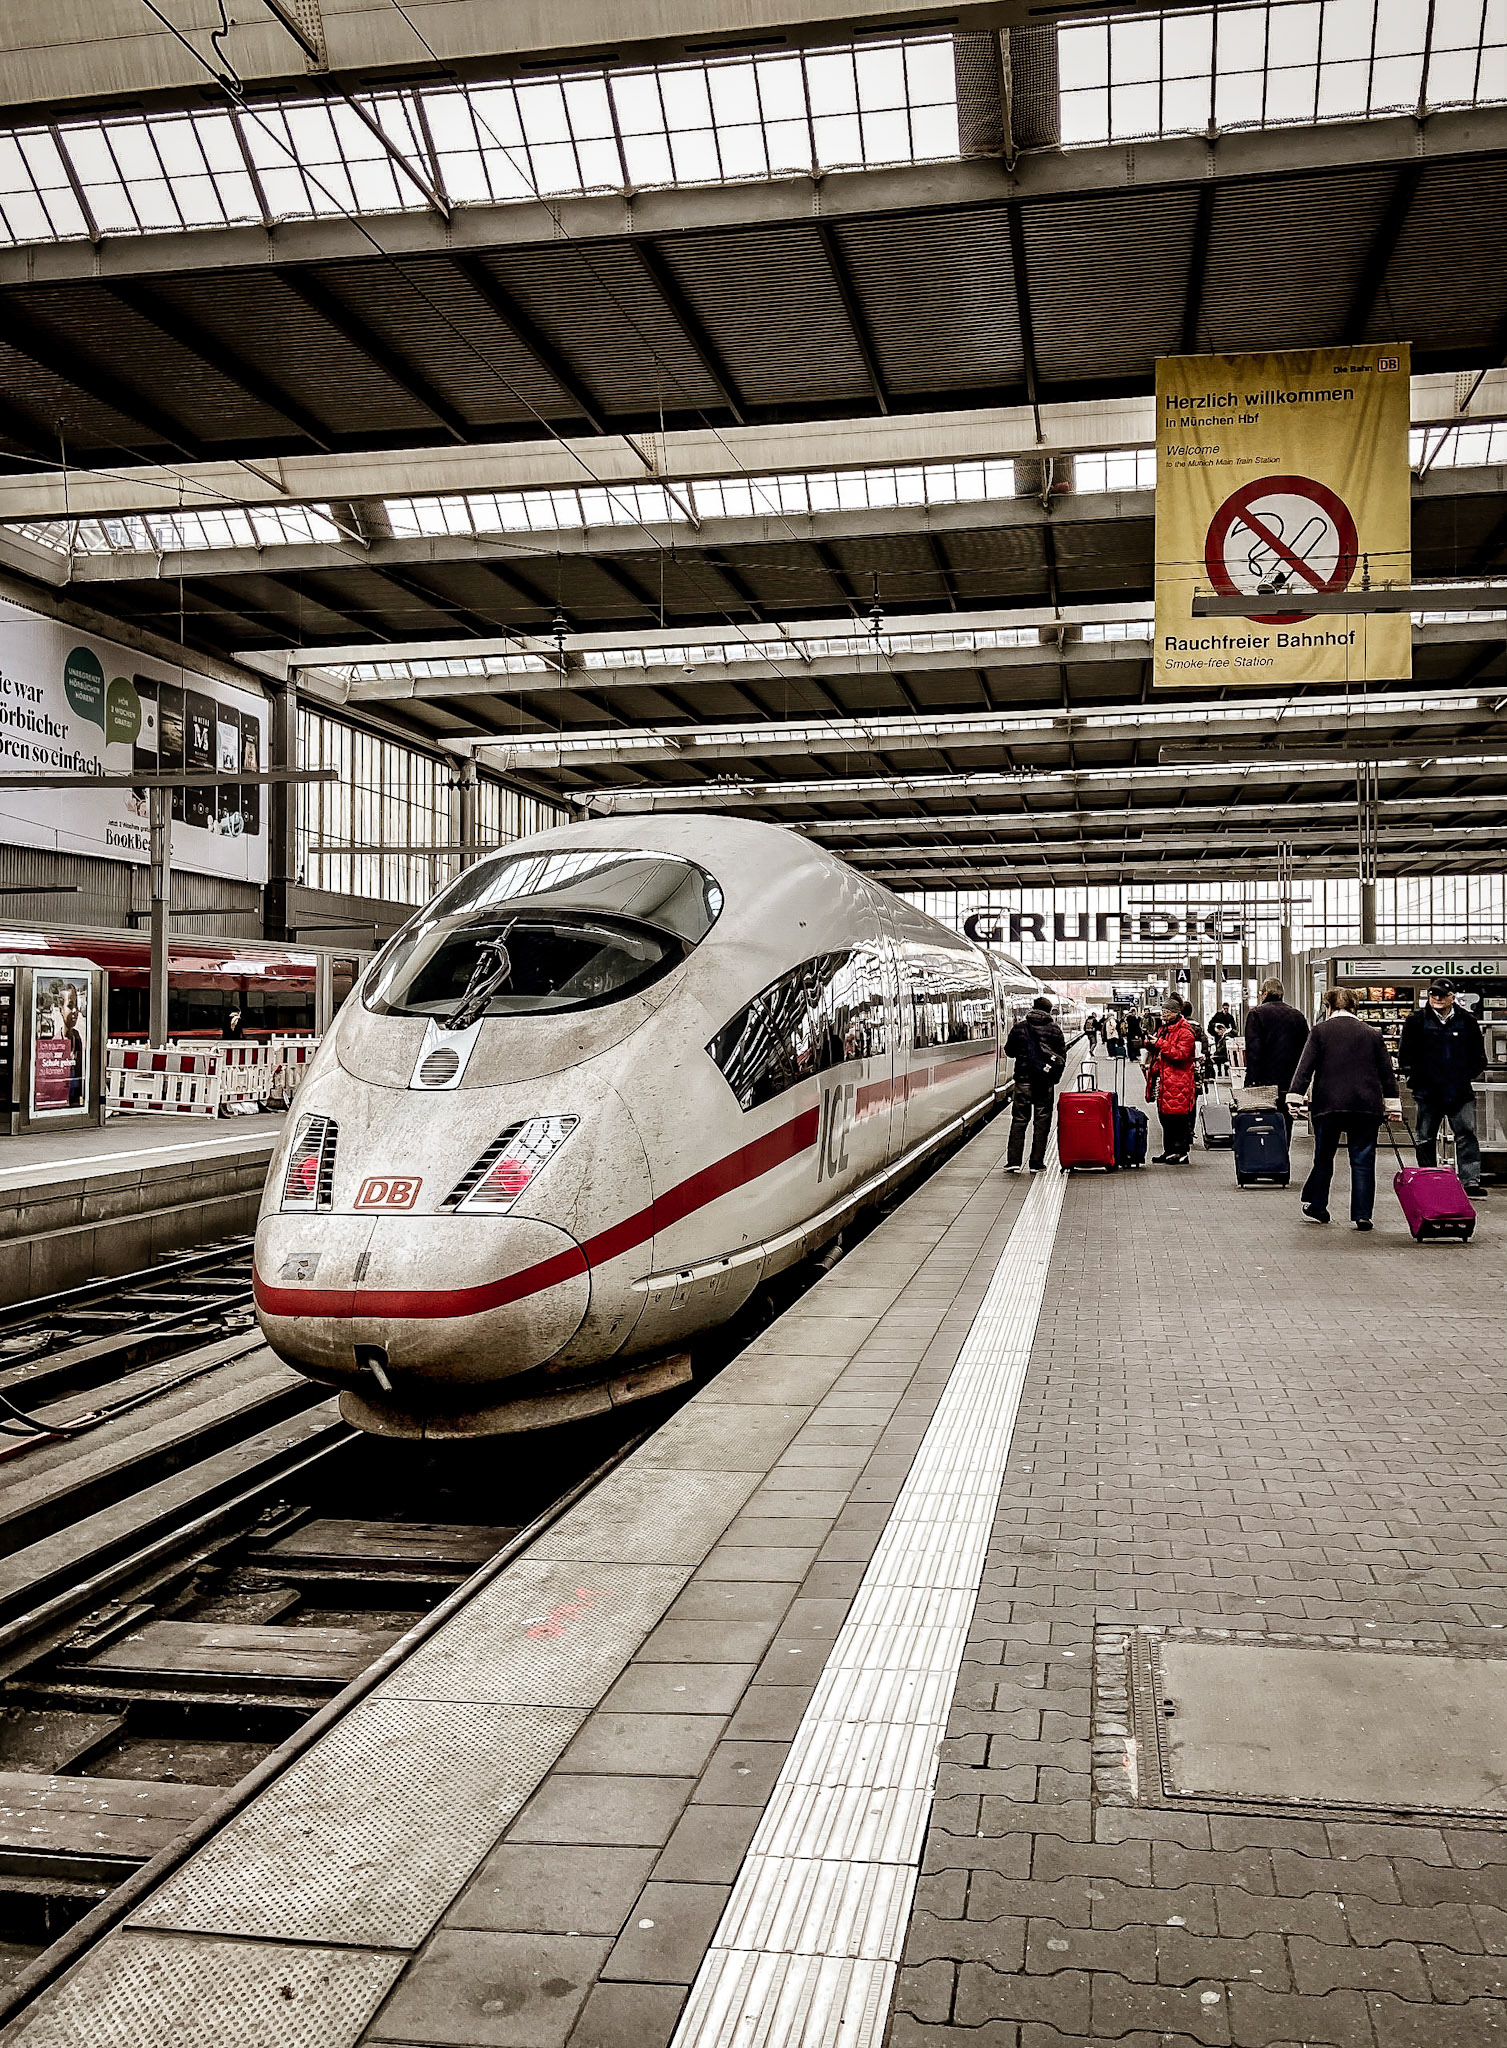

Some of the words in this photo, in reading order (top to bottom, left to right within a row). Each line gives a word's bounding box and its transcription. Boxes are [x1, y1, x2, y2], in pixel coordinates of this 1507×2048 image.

[1333, 366, 1348, 374] Die
[1350, 364, 1373, 373] Bahn
[1379, 358, 1398, 371] DB
[1166, 391, 1238, 410] Herzlich
[1245, 387, 1354, 406] willkommen
[1180, 415, 1234, 427] München
[1238, 413, 1260, 424] Hbf
[1166, 444, 1220, 456] Welcome
[1187, 459, 1214, 467] Munich
[1216, 458, 1234, 466] Main
[1236, 457, 1253, 465] Train
[1255, 456, 1281, 464] Station
[1165, 634, 1270, 651] Rauchfreier
[1277, 630, 1356, 648] Bahnhof
[1165, 658, 1230, 669] Smoke-free
[1234, 656, 1274, 667] Station
[14, 681, 44, 703] war
[32, 746, 49, 764] so
[963, 912, 1242, 943] GRUNDIG
[1088, 968, 1096, 976] 14
[1411, 961, 1495, 975] zoells.de
[1177, 970, 1187, 981] A
[42, 1058, 59, 1067] Schule
[817, 1083, 854, 1184] ICE
[360, 1180, 414, 1205] DB
